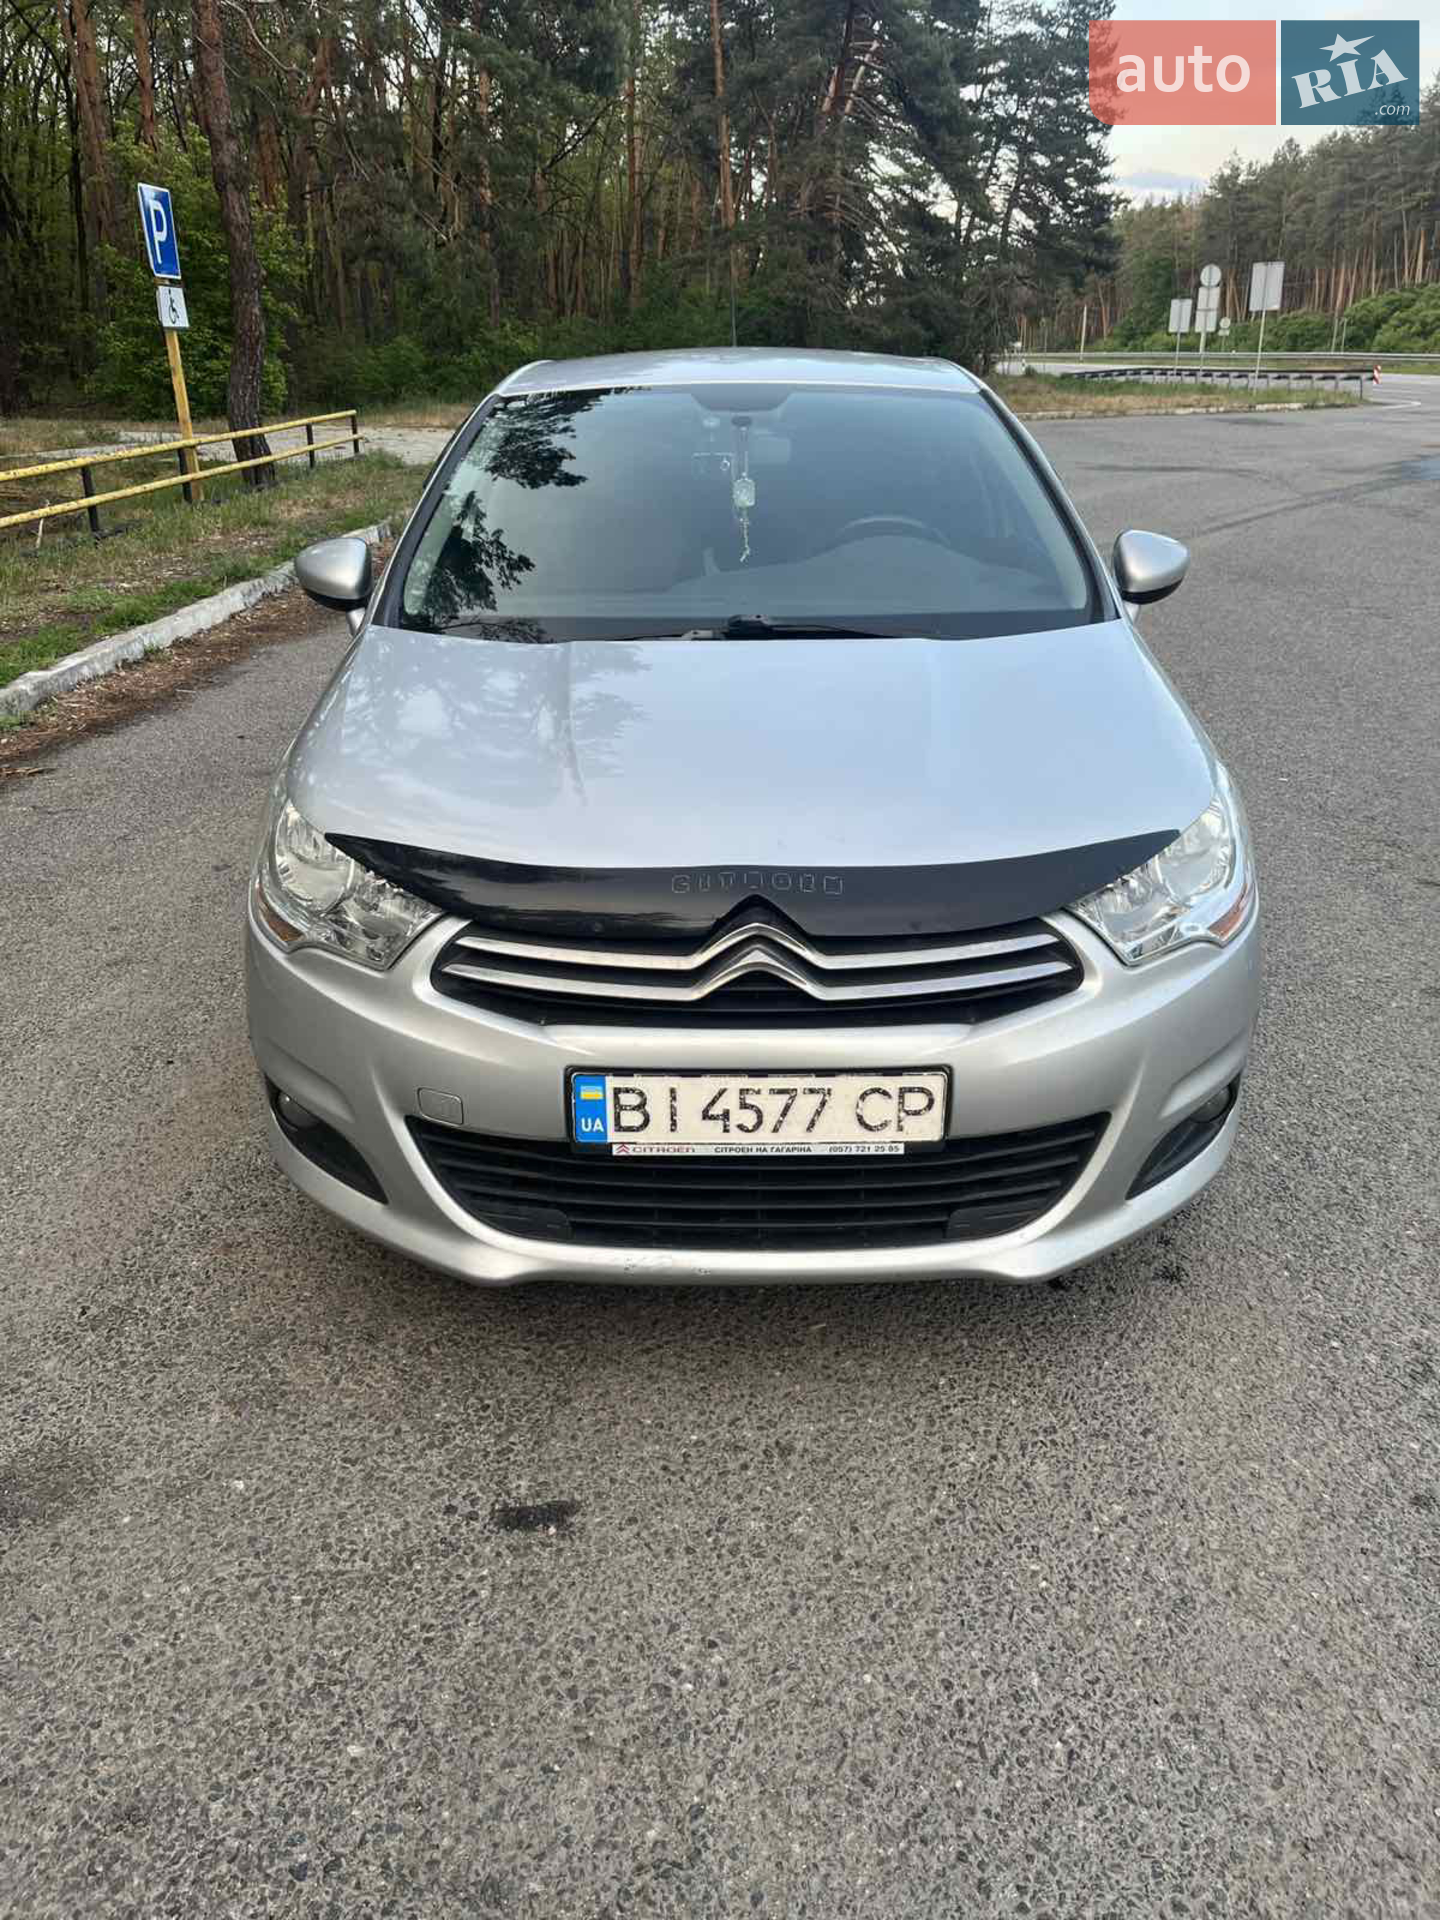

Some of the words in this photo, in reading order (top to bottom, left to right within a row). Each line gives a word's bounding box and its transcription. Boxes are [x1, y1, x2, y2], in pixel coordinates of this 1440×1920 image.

[150, 200, 168, 264] P
[581, 1118, 604, 1132] UA
[613, 1087, 677, 1133] BI
[702, 1087, 832, 1133] 4577
[855, 1087, 935, 1132] CP
